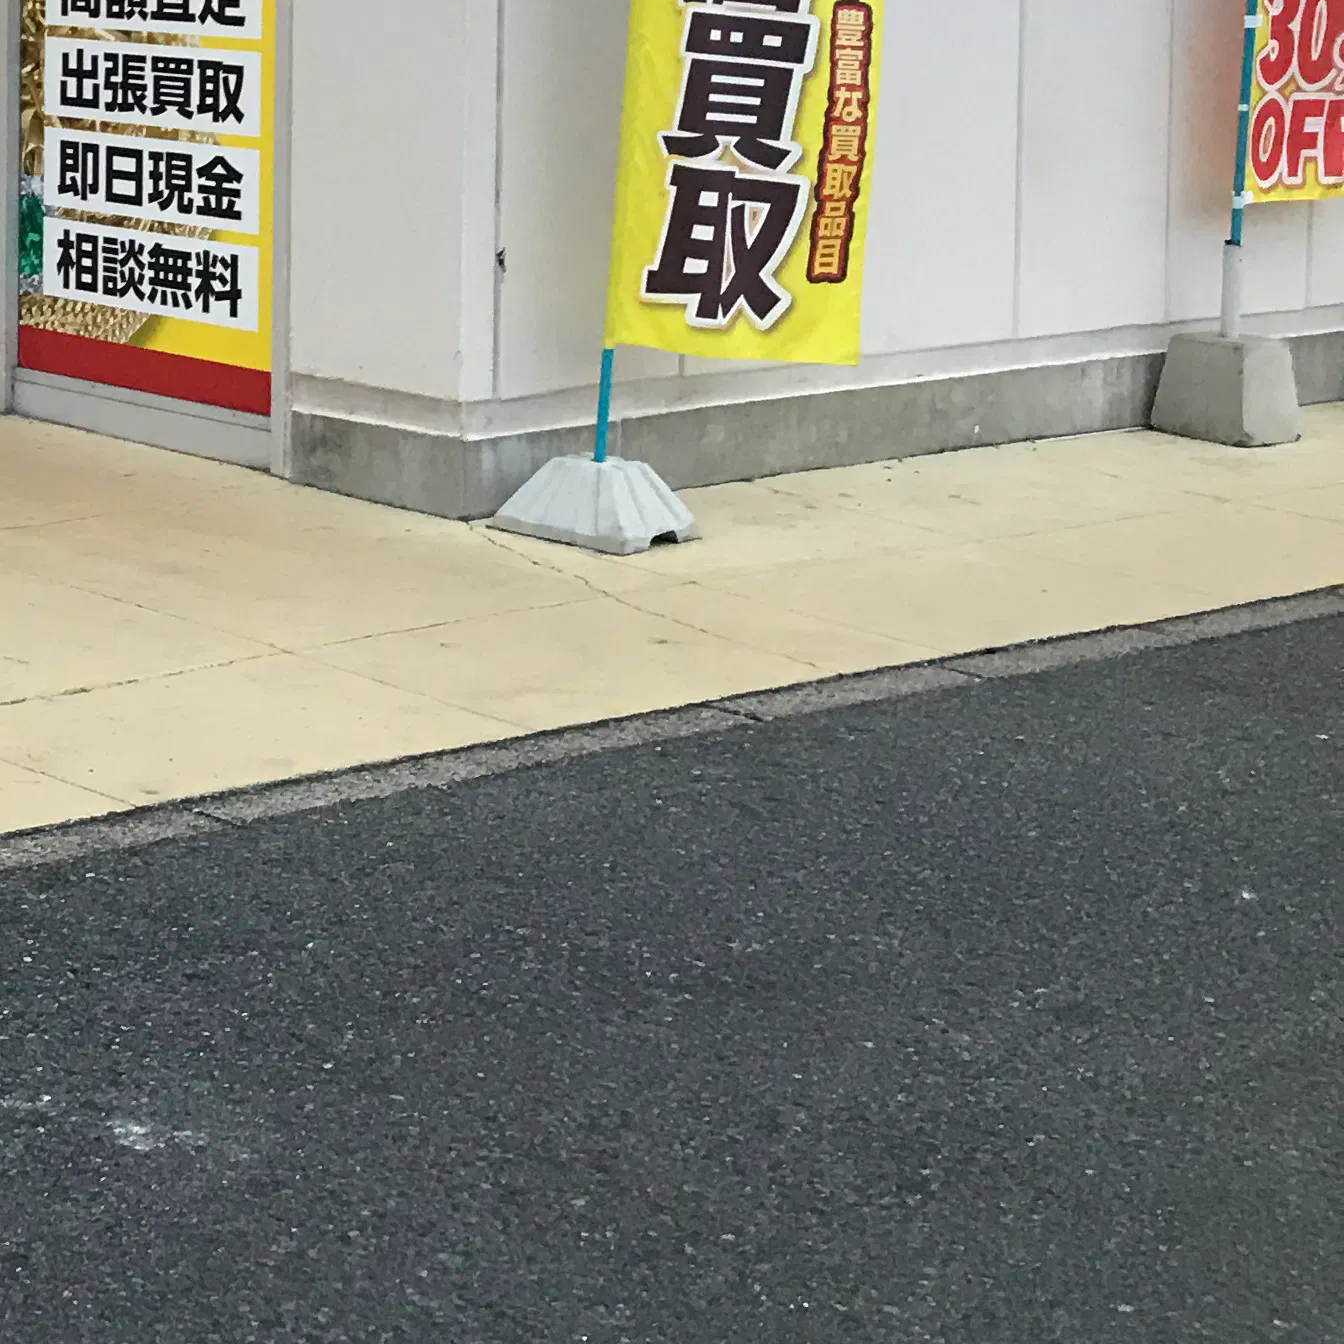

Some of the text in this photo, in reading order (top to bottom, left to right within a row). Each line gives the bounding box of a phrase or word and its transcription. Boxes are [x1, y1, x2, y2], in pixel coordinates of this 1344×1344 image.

[58, 49, 245, 123] 出張買取
[57, 136, 244, 222] 即日現金
[57, 228, 242, 320] 相談無料
